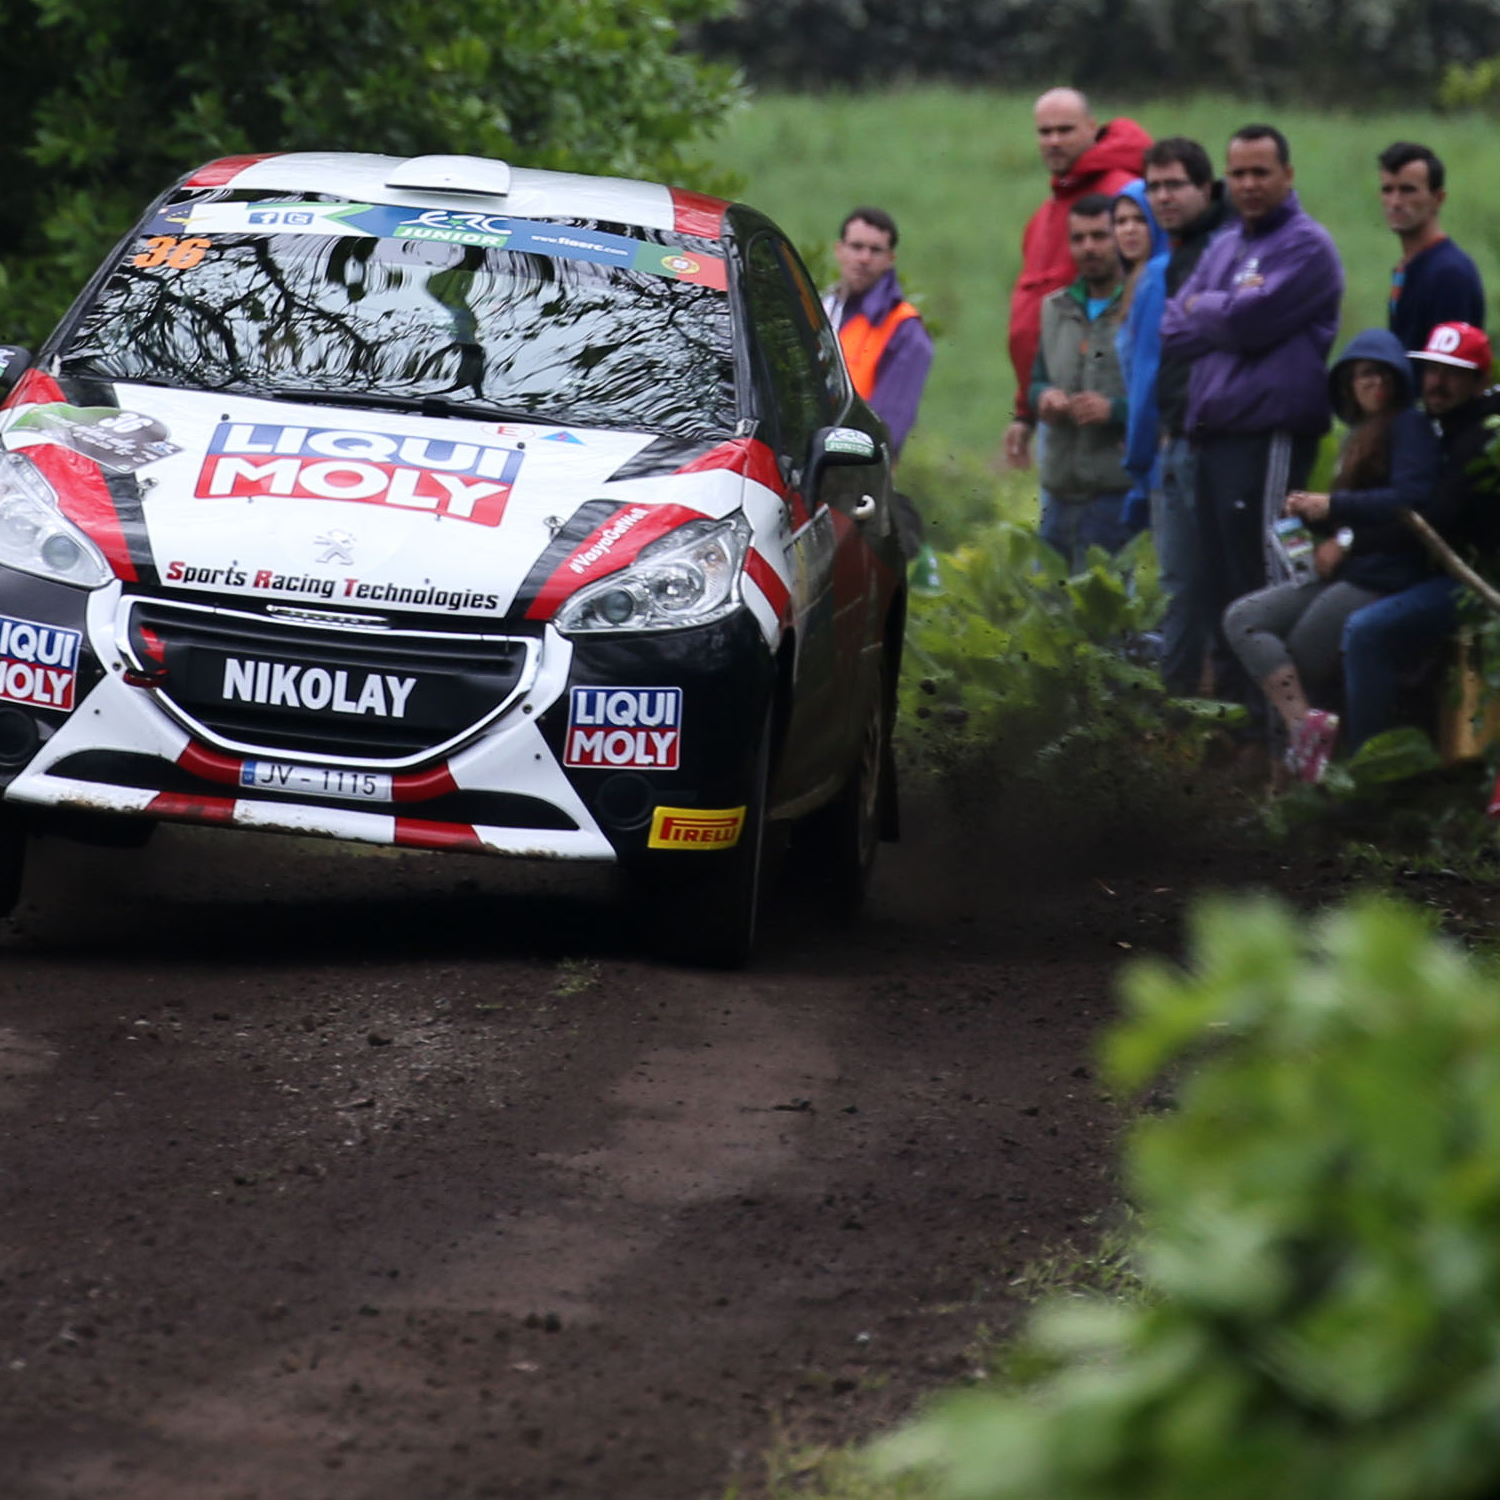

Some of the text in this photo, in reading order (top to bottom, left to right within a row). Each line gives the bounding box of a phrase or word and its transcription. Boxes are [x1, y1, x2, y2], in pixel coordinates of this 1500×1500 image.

[133, 236, 212, 270] 36
[401, 228, 500, 244] JUNIOR
[223, 425, 503, 479] LIQUI
[209, 457, 509, 518] MOLY
[166, 561, 499, 611] Sports Racing Technologies
[222, 658, 417, 718] NIKOLAY
[575, 691, 676, 727] LIQUI
[570, 730, 677, 765] MOLY
[659, 817, 740, 843] PIRELLI
